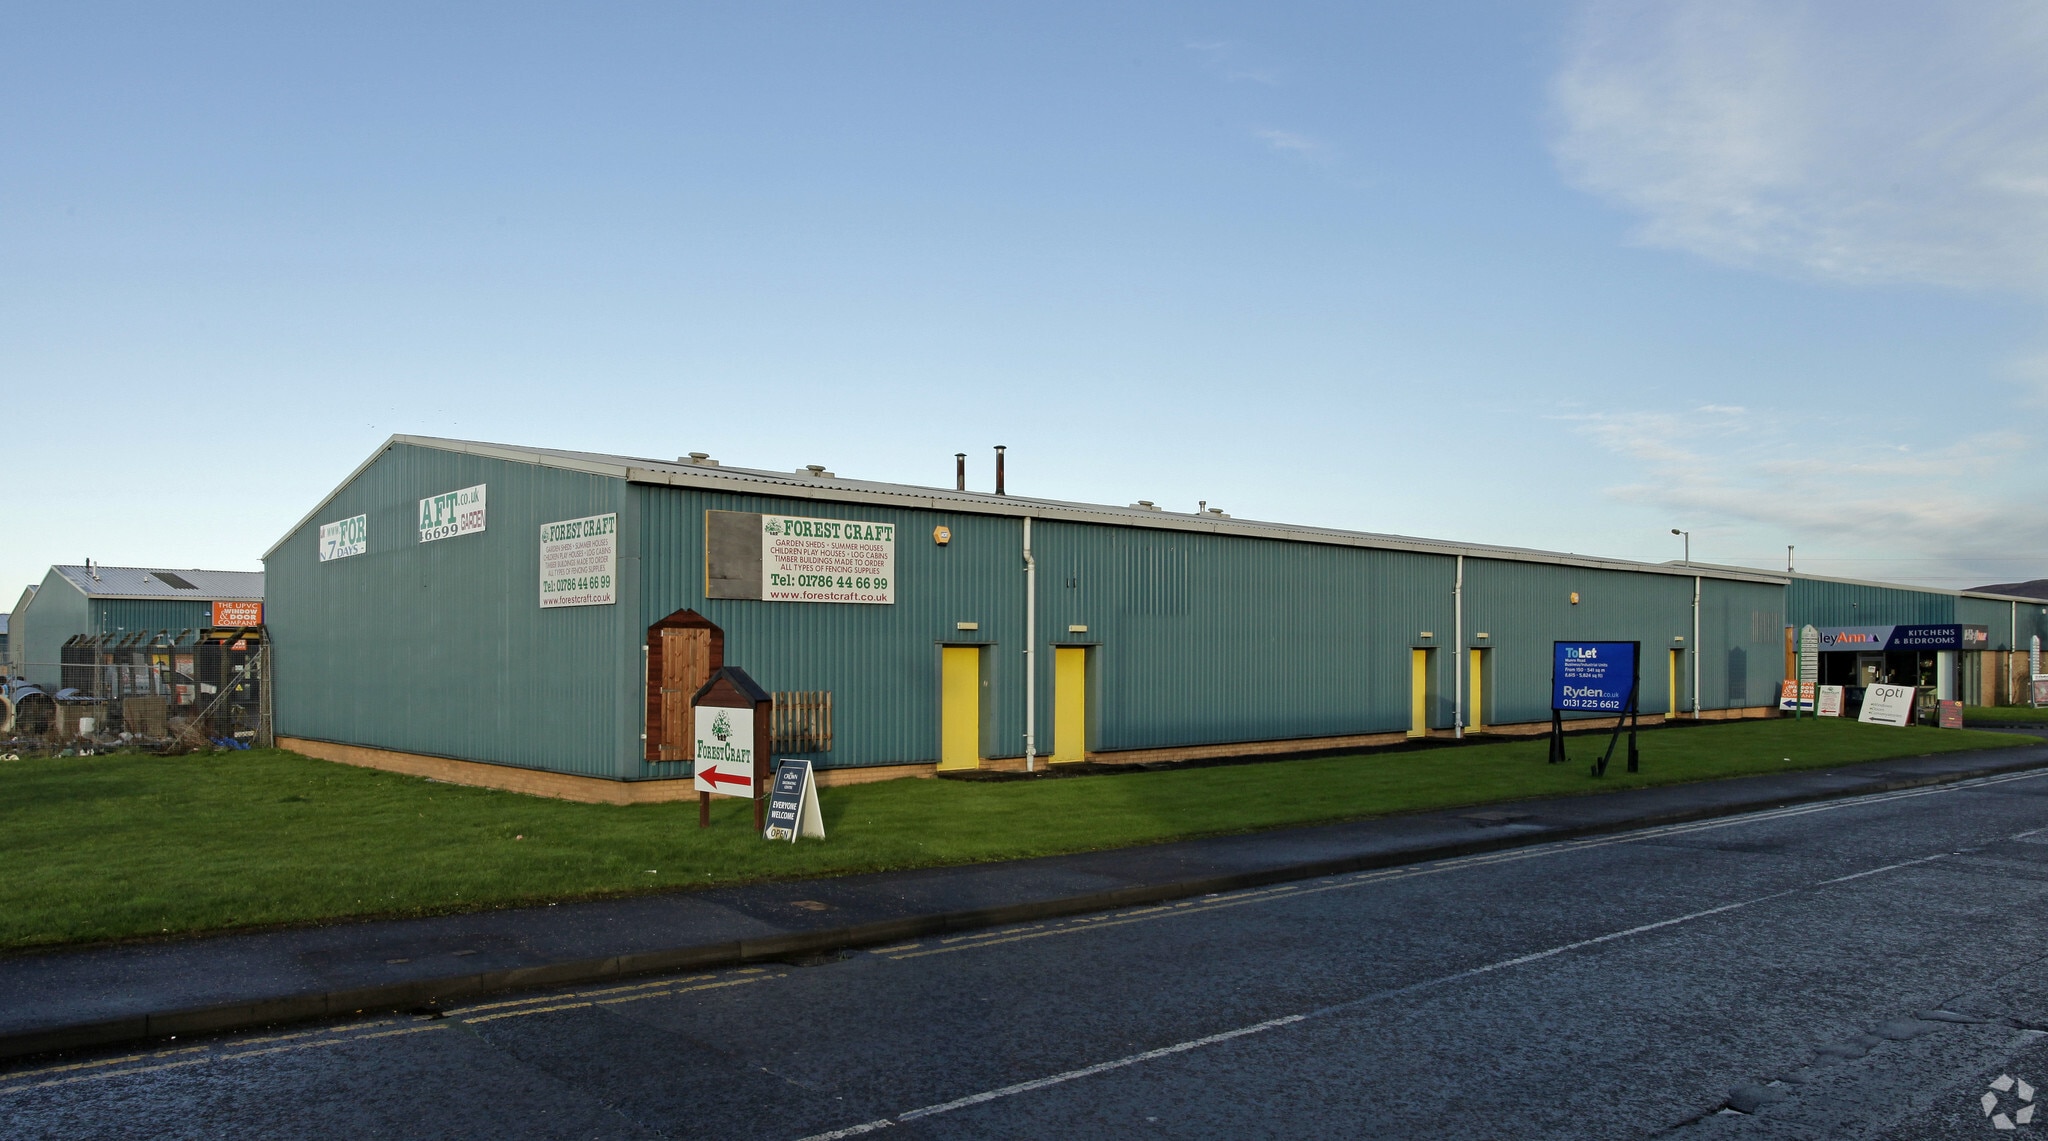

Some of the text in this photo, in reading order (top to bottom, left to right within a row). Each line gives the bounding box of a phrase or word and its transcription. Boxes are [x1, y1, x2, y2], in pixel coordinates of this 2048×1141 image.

[550, 517, 614, 542] FOREST CRAFT
[784, 520, 892, 541] FOREST CRAFT
[328, 540, 336, 560] 7
[337, 544, 358, 558] DAYS
[546, 539, 608, 553] GARDEN SHEDS SUMMER HOUSES
[776, 539, 883, 551] GARDEN SHEDS SUMMER HOUSES
[569, 550, 583, 558] HOUSES
[596, 547, 611, 555] CABINS
[770, 547, 802, 555] CHILDREN
[821, 549, 845, 557] HOUSES
[851, 550, 864, 558] LOG
[866, 552, 888, 560] CABINS
[558, 560, 575, 568] BUILDINGS
[775, 555, 798, 563] TIMBER
[800, 556, 833, 565] BUILDINGS
[834, 558, 853, 566] MADE
[864, 559, 885, 567] ORDER
[589, 564, 605, 572] SUPPLIES
[780, 563, 792, 571] ALL
[794, 564, 813, 572] TYPES
[825, 565, 853, 574] FENCING
[854, 566, 880, 575] SUPPLIES
[544, 575, 611, 593] Tel: 01786 44 66 99
[771, 573, 888, 589] Tel: 01786 44 66 99
[543, 593, 611, 605] www.forestcraft.co.uk
[770, 591, 888, 602] www.forestcraft.co.uk
[219, 610, 229, 620] &
[1904, 637, 1955, 645] BEDROOMS
[1875, 688, 1903, 702] opti
[1563, 699, 1619, 709] 0131 225 6612
[773, 801, 797, 810] EVERYONE
[772, 811, 795, 820] WELCOME
[770, 829, 789, 839] OPEN
